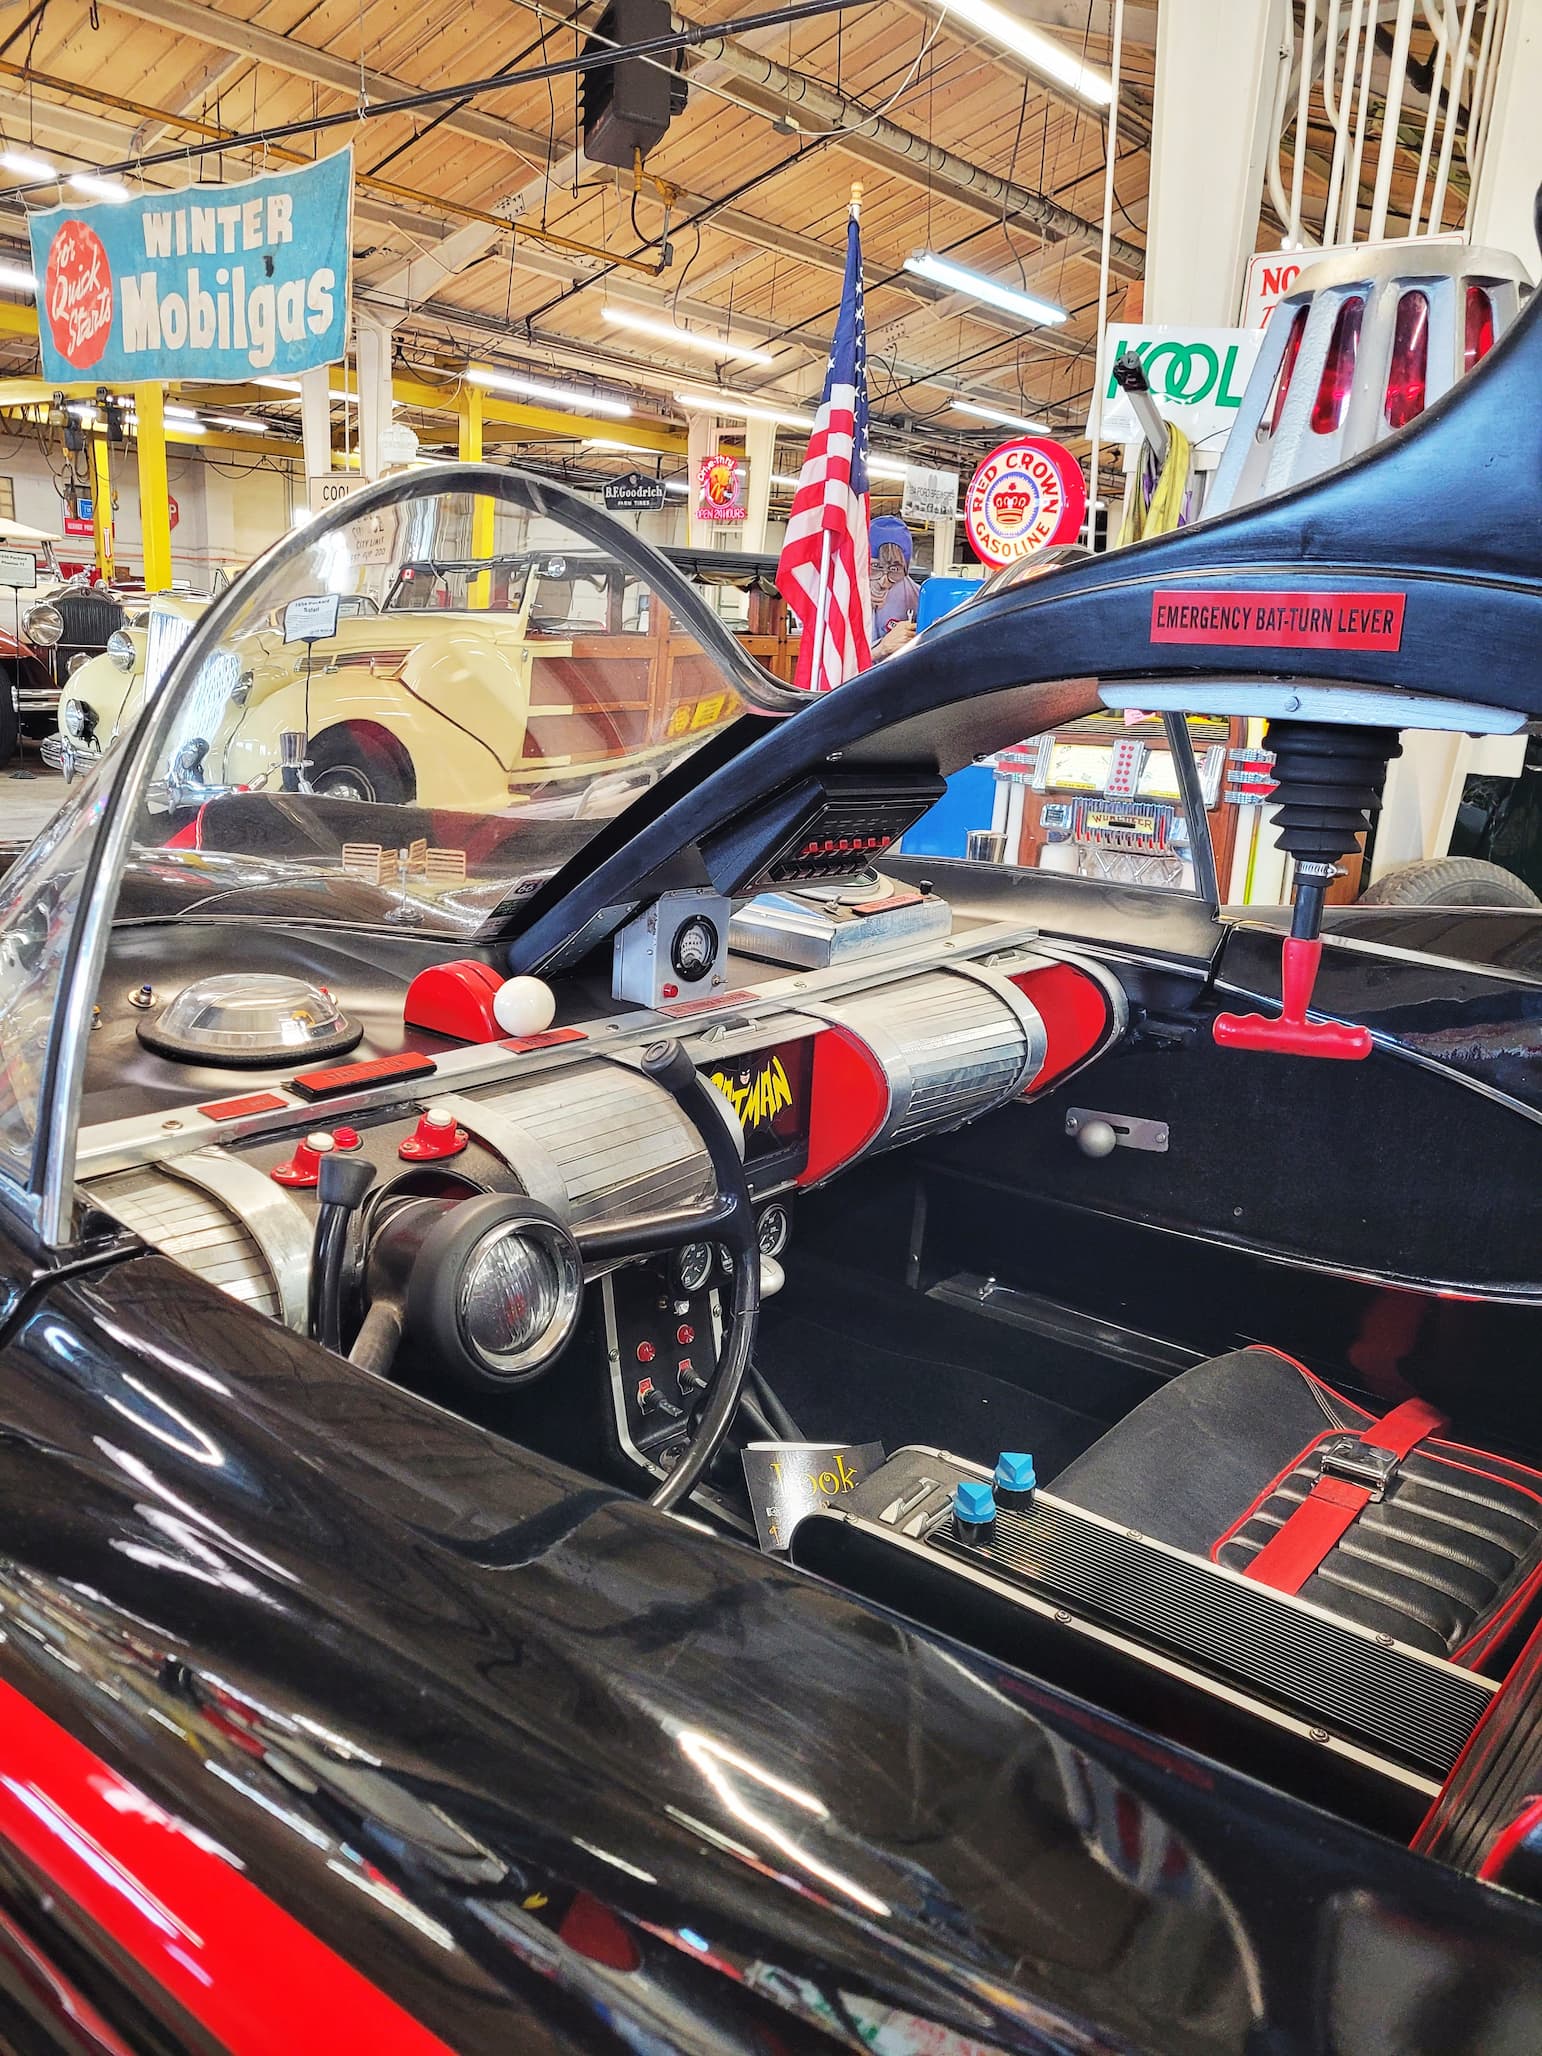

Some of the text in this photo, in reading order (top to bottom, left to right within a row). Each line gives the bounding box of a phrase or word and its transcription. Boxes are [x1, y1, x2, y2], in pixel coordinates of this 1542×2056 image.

[55, 229, 76, 276] For
[142, 193, 293, 258] WINTER
[52, 243, 101, 322] Quick
[67, 287, 112, 357] Starts
[120, 266, 335, 369] Mobilgas
[1106, 340, 1243, 408] KOOL
[972, 453, 1059, 514] RED CROWN
[976, 522, 1050, 557] GASOLINE
[1157, 606, 1394, 634] EMERGENCY BAT-TURN LEVER
